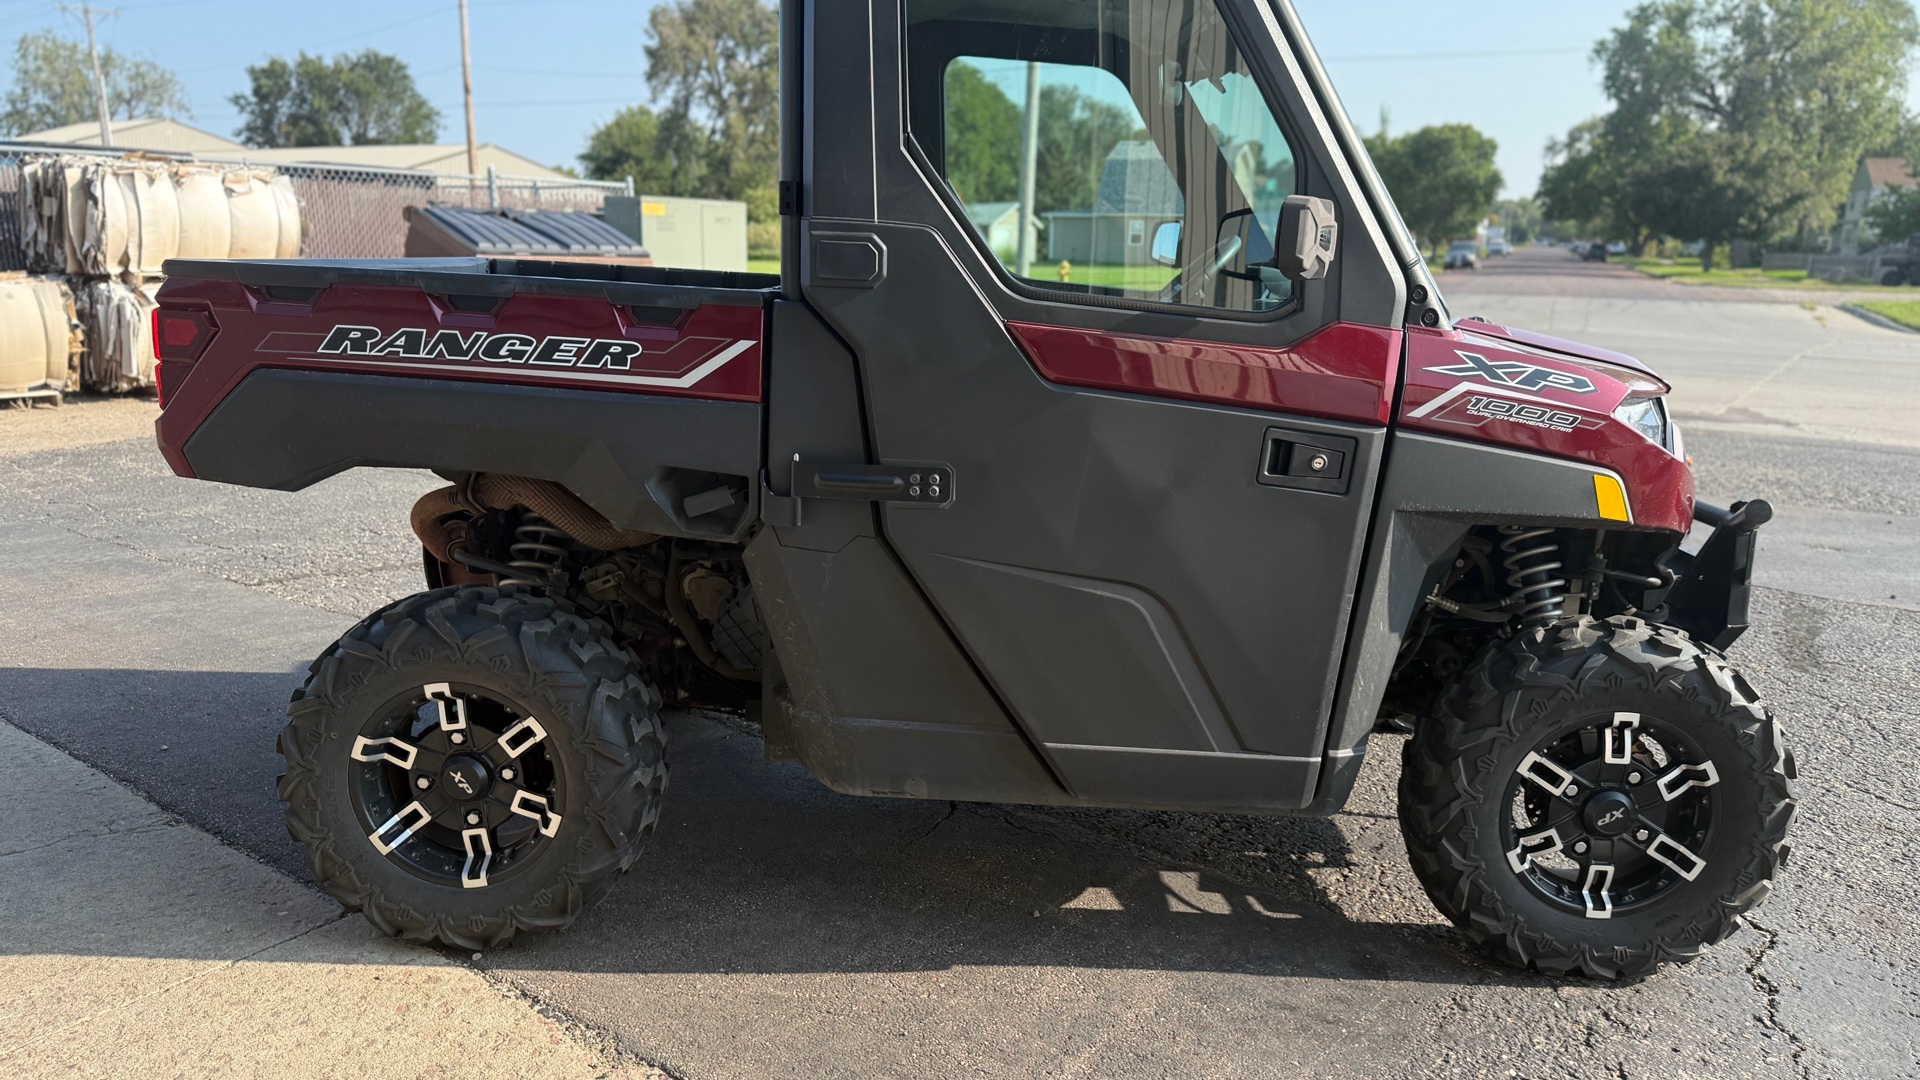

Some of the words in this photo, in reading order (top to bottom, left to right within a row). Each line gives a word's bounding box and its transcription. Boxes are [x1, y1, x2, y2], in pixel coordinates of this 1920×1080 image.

[316, 324, 643, 370] RANGER
[1421, 349, 1600, 393] XP
[1466, 395, 1582, 428] 1000
[1466, 409, 1495, 418] DUAL
[1495, 414, 1549, 428] OVERHEAD
[1550, 424, 1573, 433] CAM
[449, 771, 473, 794] XP
[1597, 807, 1625, 826] XP
